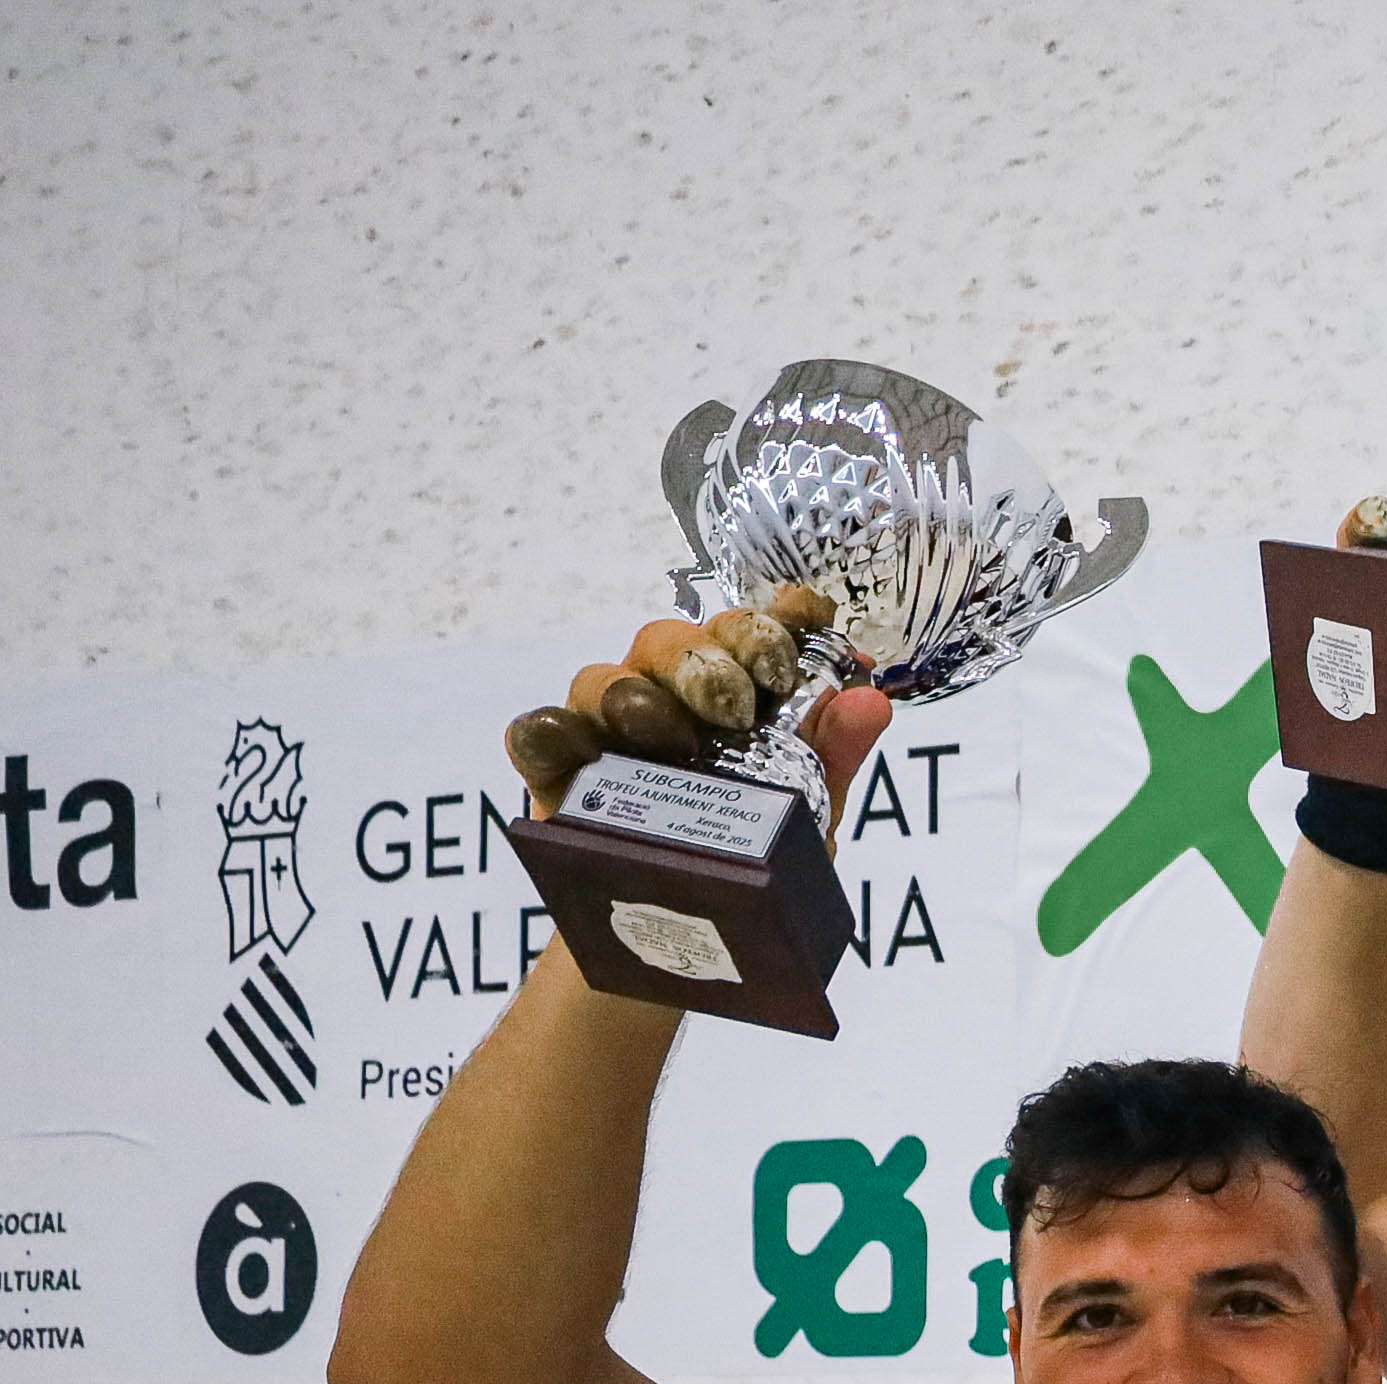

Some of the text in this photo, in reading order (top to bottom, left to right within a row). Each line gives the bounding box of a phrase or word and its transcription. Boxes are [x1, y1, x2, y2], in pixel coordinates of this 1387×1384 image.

[597, 778, 762, 823] TROFEU AJUNTAMENT XERACO
[632, 769, 742, 802] SUBCAMPIÓ
[713, 832, 726, 842] de
[728, 834, 753, 848] 2025
[360, 1051, 454, 1099] Presi
